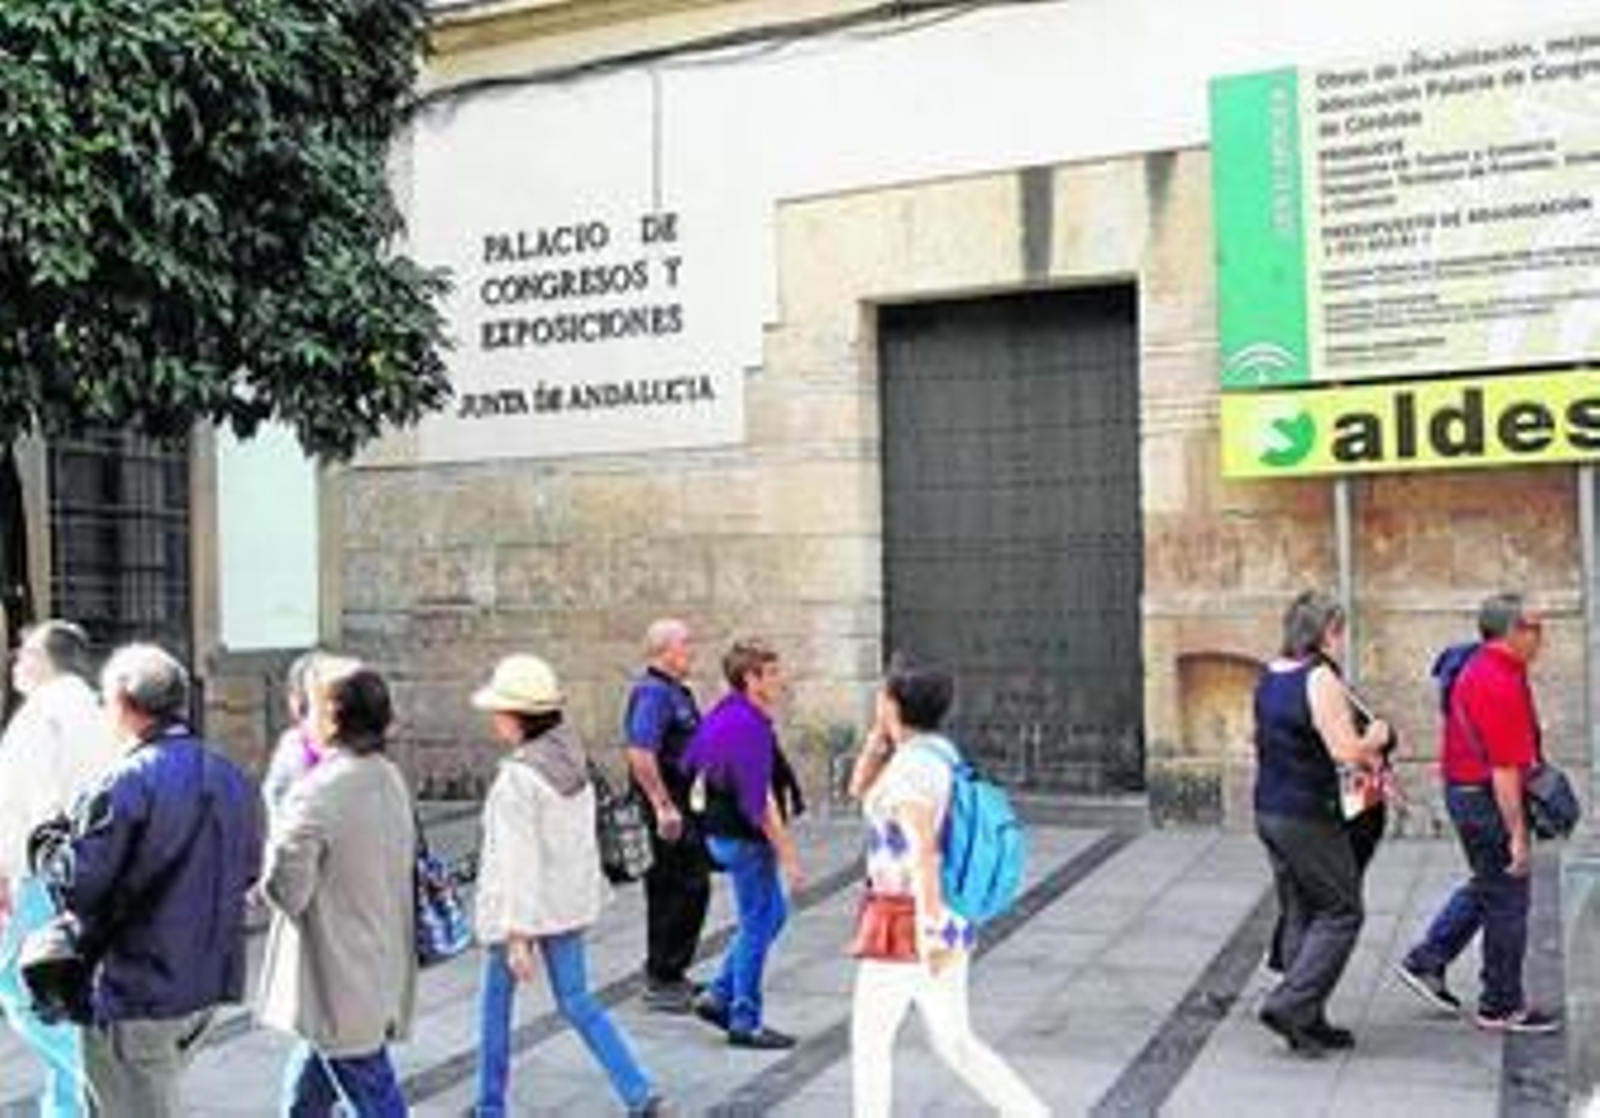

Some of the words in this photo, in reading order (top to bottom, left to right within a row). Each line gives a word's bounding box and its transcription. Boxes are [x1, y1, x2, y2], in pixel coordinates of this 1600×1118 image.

[1374, 63, 1397, 80] de
[1502, 69, 1525, 89] de
[483, 220, 609, 264] PALACIO
[641, 212, 678, 244] DE
[480, 260, 649, 305] CONGRESOS
[663, 256, 682, 287] Y
[480, 304, 683, 351] EXPOSICIONES
[457, 389, 529, 419] JUNTA
[534, 384, 563, 413] DE
